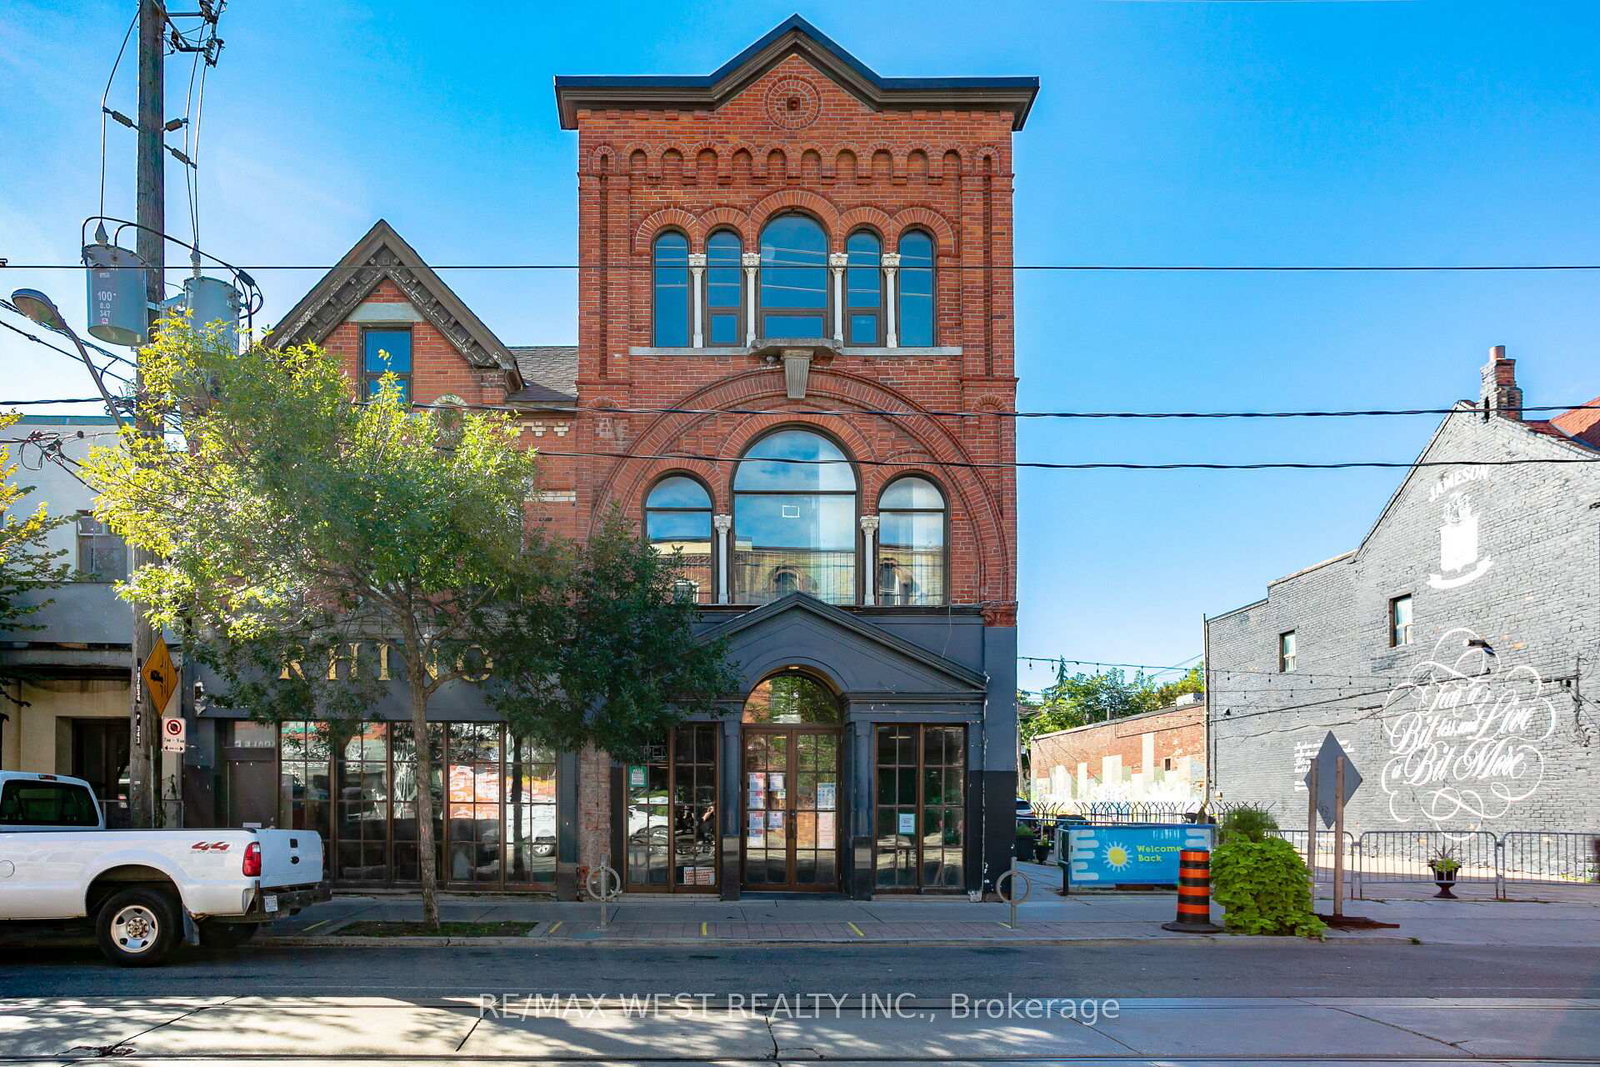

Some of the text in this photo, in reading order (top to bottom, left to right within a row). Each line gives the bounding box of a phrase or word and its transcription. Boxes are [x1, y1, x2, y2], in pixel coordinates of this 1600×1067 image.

[97, 291, 112, 301] 100
[1136, 845, 1182, 853] Welcome
[1138, 854, 1161, 862] Back
